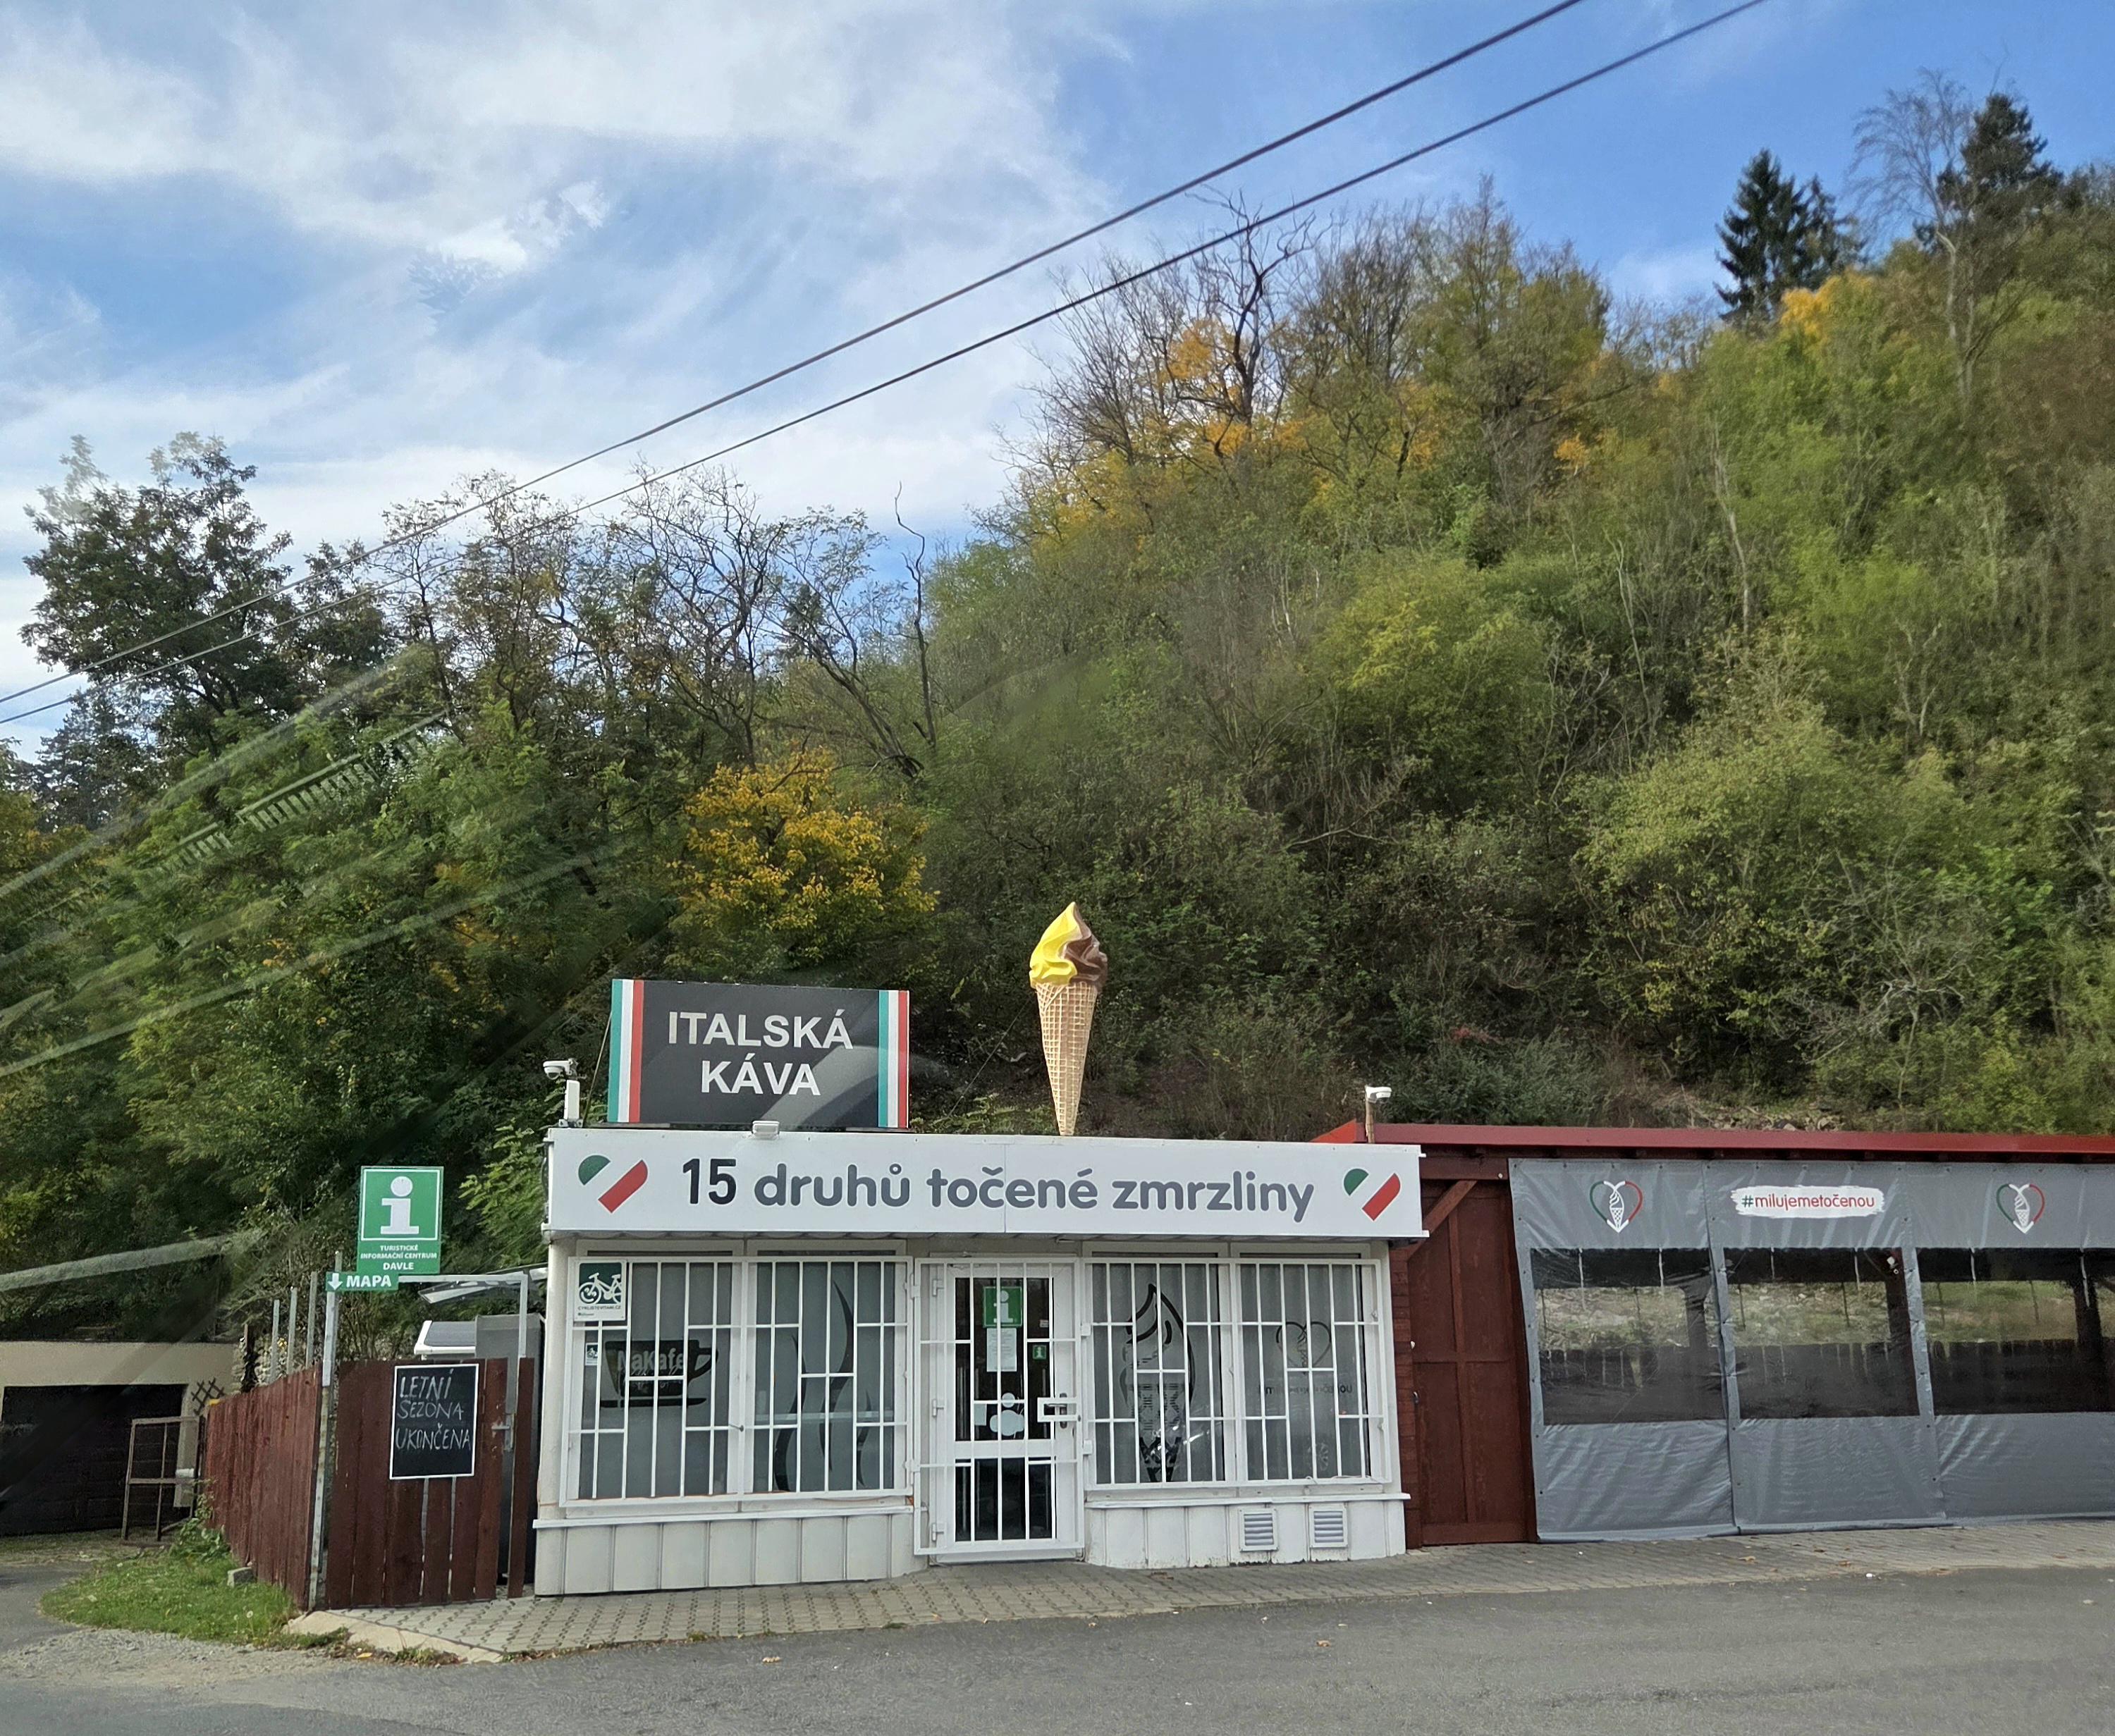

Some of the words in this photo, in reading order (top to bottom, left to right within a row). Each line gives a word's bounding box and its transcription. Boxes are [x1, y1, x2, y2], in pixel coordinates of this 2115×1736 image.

[668, 1009, 853, 1049] ITALSKÁ
[701, 1053, 821, 1096] KÁVA
[682, 1159, 737, 1205] 15
[754, 1163, 910, 1207] druhů
[927, 1167, 1098, 1209] točené
[1112, 1171, 1314, 1223] zmrzliny
[1741, 1193, 1875, 1211] #milujemetočenou
[346, 1274, 392, 1288] MAPA
[383, 1262, 414, 1270] DAVLE
[400, 1368, 454, 1400] LETNÍ
[396, 1422, 472, 1451] UKONČENA
